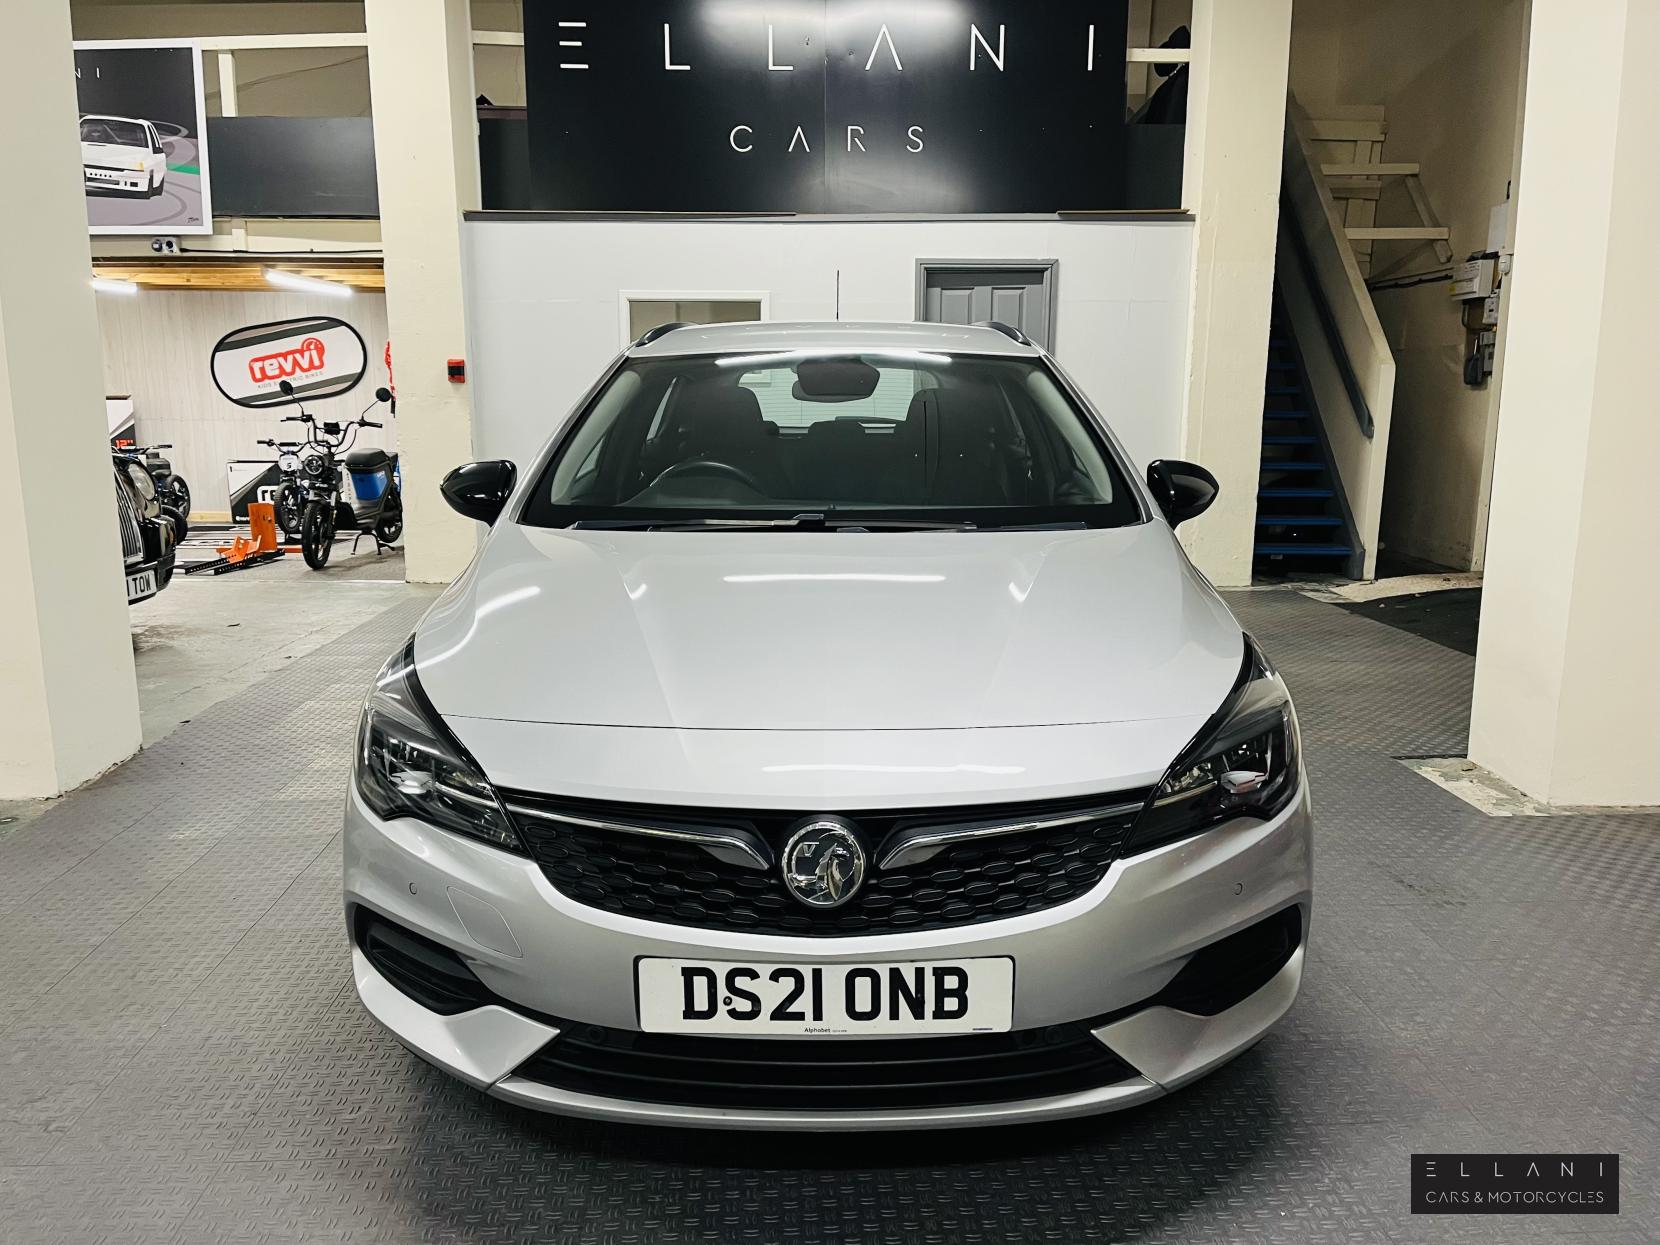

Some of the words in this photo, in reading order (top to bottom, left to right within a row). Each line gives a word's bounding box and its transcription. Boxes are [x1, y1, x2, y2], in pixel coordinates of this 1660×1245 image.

[558, 22, 1095, 71] ELLANI
[729, 125, 923, 153] CARS
[250, 344, 321, 379] revvi
[681, 967, 823, 1021] DS21
[844, 966, 968, 1021] ONB
